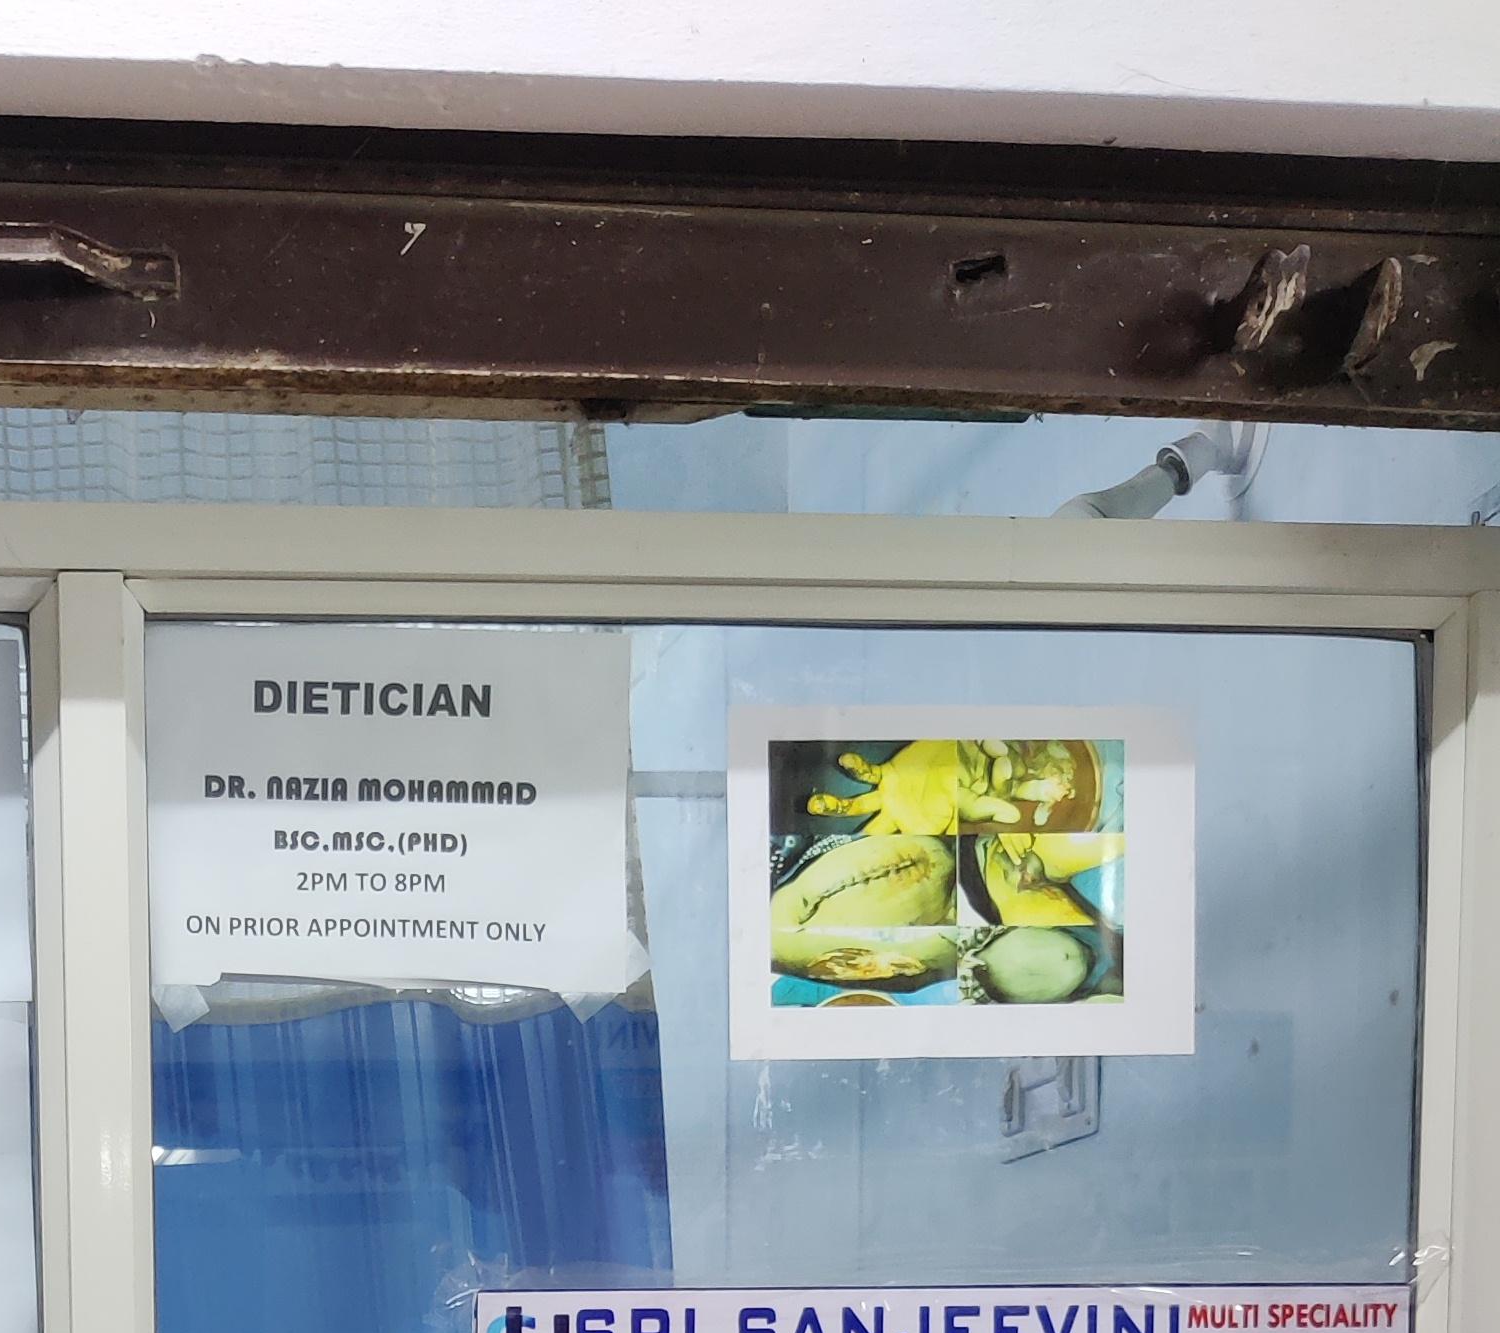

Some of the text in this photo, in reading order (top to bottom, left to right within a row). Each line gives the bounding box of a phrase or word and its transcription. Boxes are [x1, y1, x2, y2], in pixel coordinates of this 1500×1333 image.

[254, 680, 491, 717] DIETICIAN
[205, 775, 536, 804] DR. NAZIA MOHAMMAD
[297, 872, 444, 892] 2PM TO 8PM
[187, 916, 545, 942] ON PRIOR APPOINTMENT ONLY
[1188, 1304, 1398, 1328] MULTI SPECIALITY
